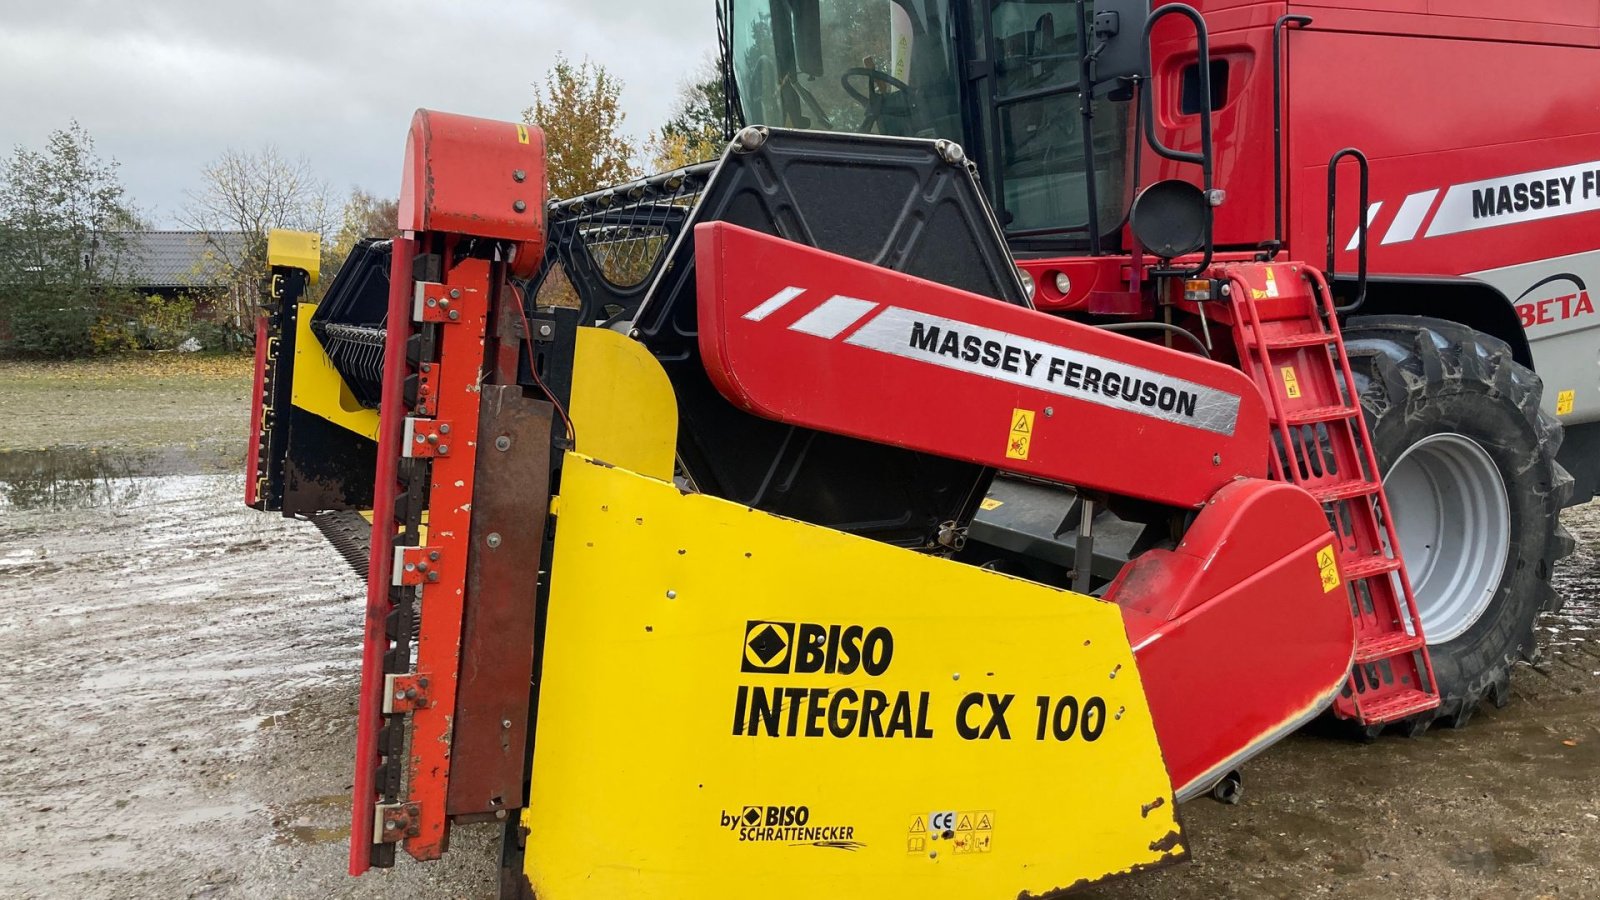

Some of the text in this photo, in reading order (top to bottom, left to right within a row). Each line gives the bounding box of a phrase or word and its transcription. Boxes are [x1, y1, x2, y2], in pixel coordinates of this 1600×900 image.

[1472, 176, 1576, 219] MASSEY
[1514, 291, 1594, 329] BETA
[909, 321, 1197, 416] MASSEY FERGUSON
[795, 623, 893, 676] BISO
[732, 685, 1106, 742] INTEGRAL CX 100
[720, 806, 809, 830] by BISO
[739, 826, 854, 841] SCHRATTENECKER
